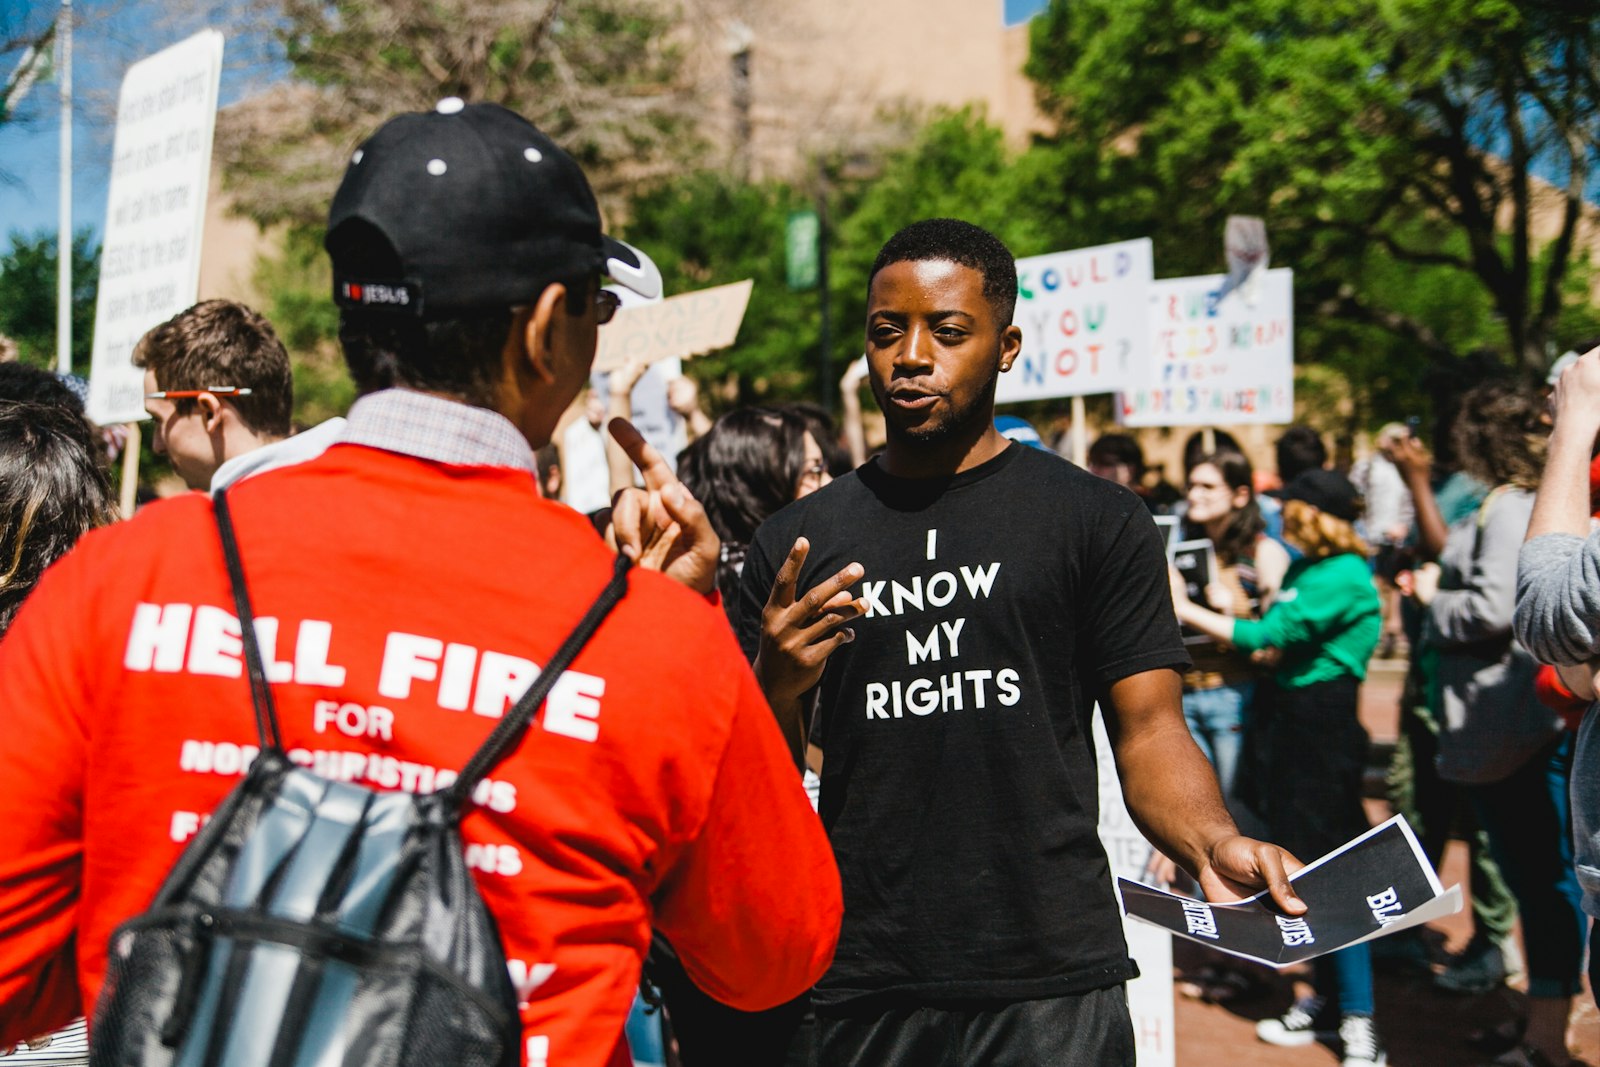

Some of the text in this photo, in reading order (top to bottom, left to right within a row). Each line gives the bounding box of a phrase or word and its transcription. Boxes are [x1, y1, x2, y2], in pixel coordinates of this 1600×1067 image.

[363, 284, 410, 306] JESUS
[1028, 303, 1107, 347] YOU
[926, 528, 937, 561] I
[862, 562, 1001, 618] KNOW
[905, 618, 966, 665] MY
[124, 602, 607, 743] HELL FIRE
[866, 668, 1021, 720] RIGHTS
[313, 699, 394, 742] FOR
[1179, 898, 1220, 940] ATTER!
